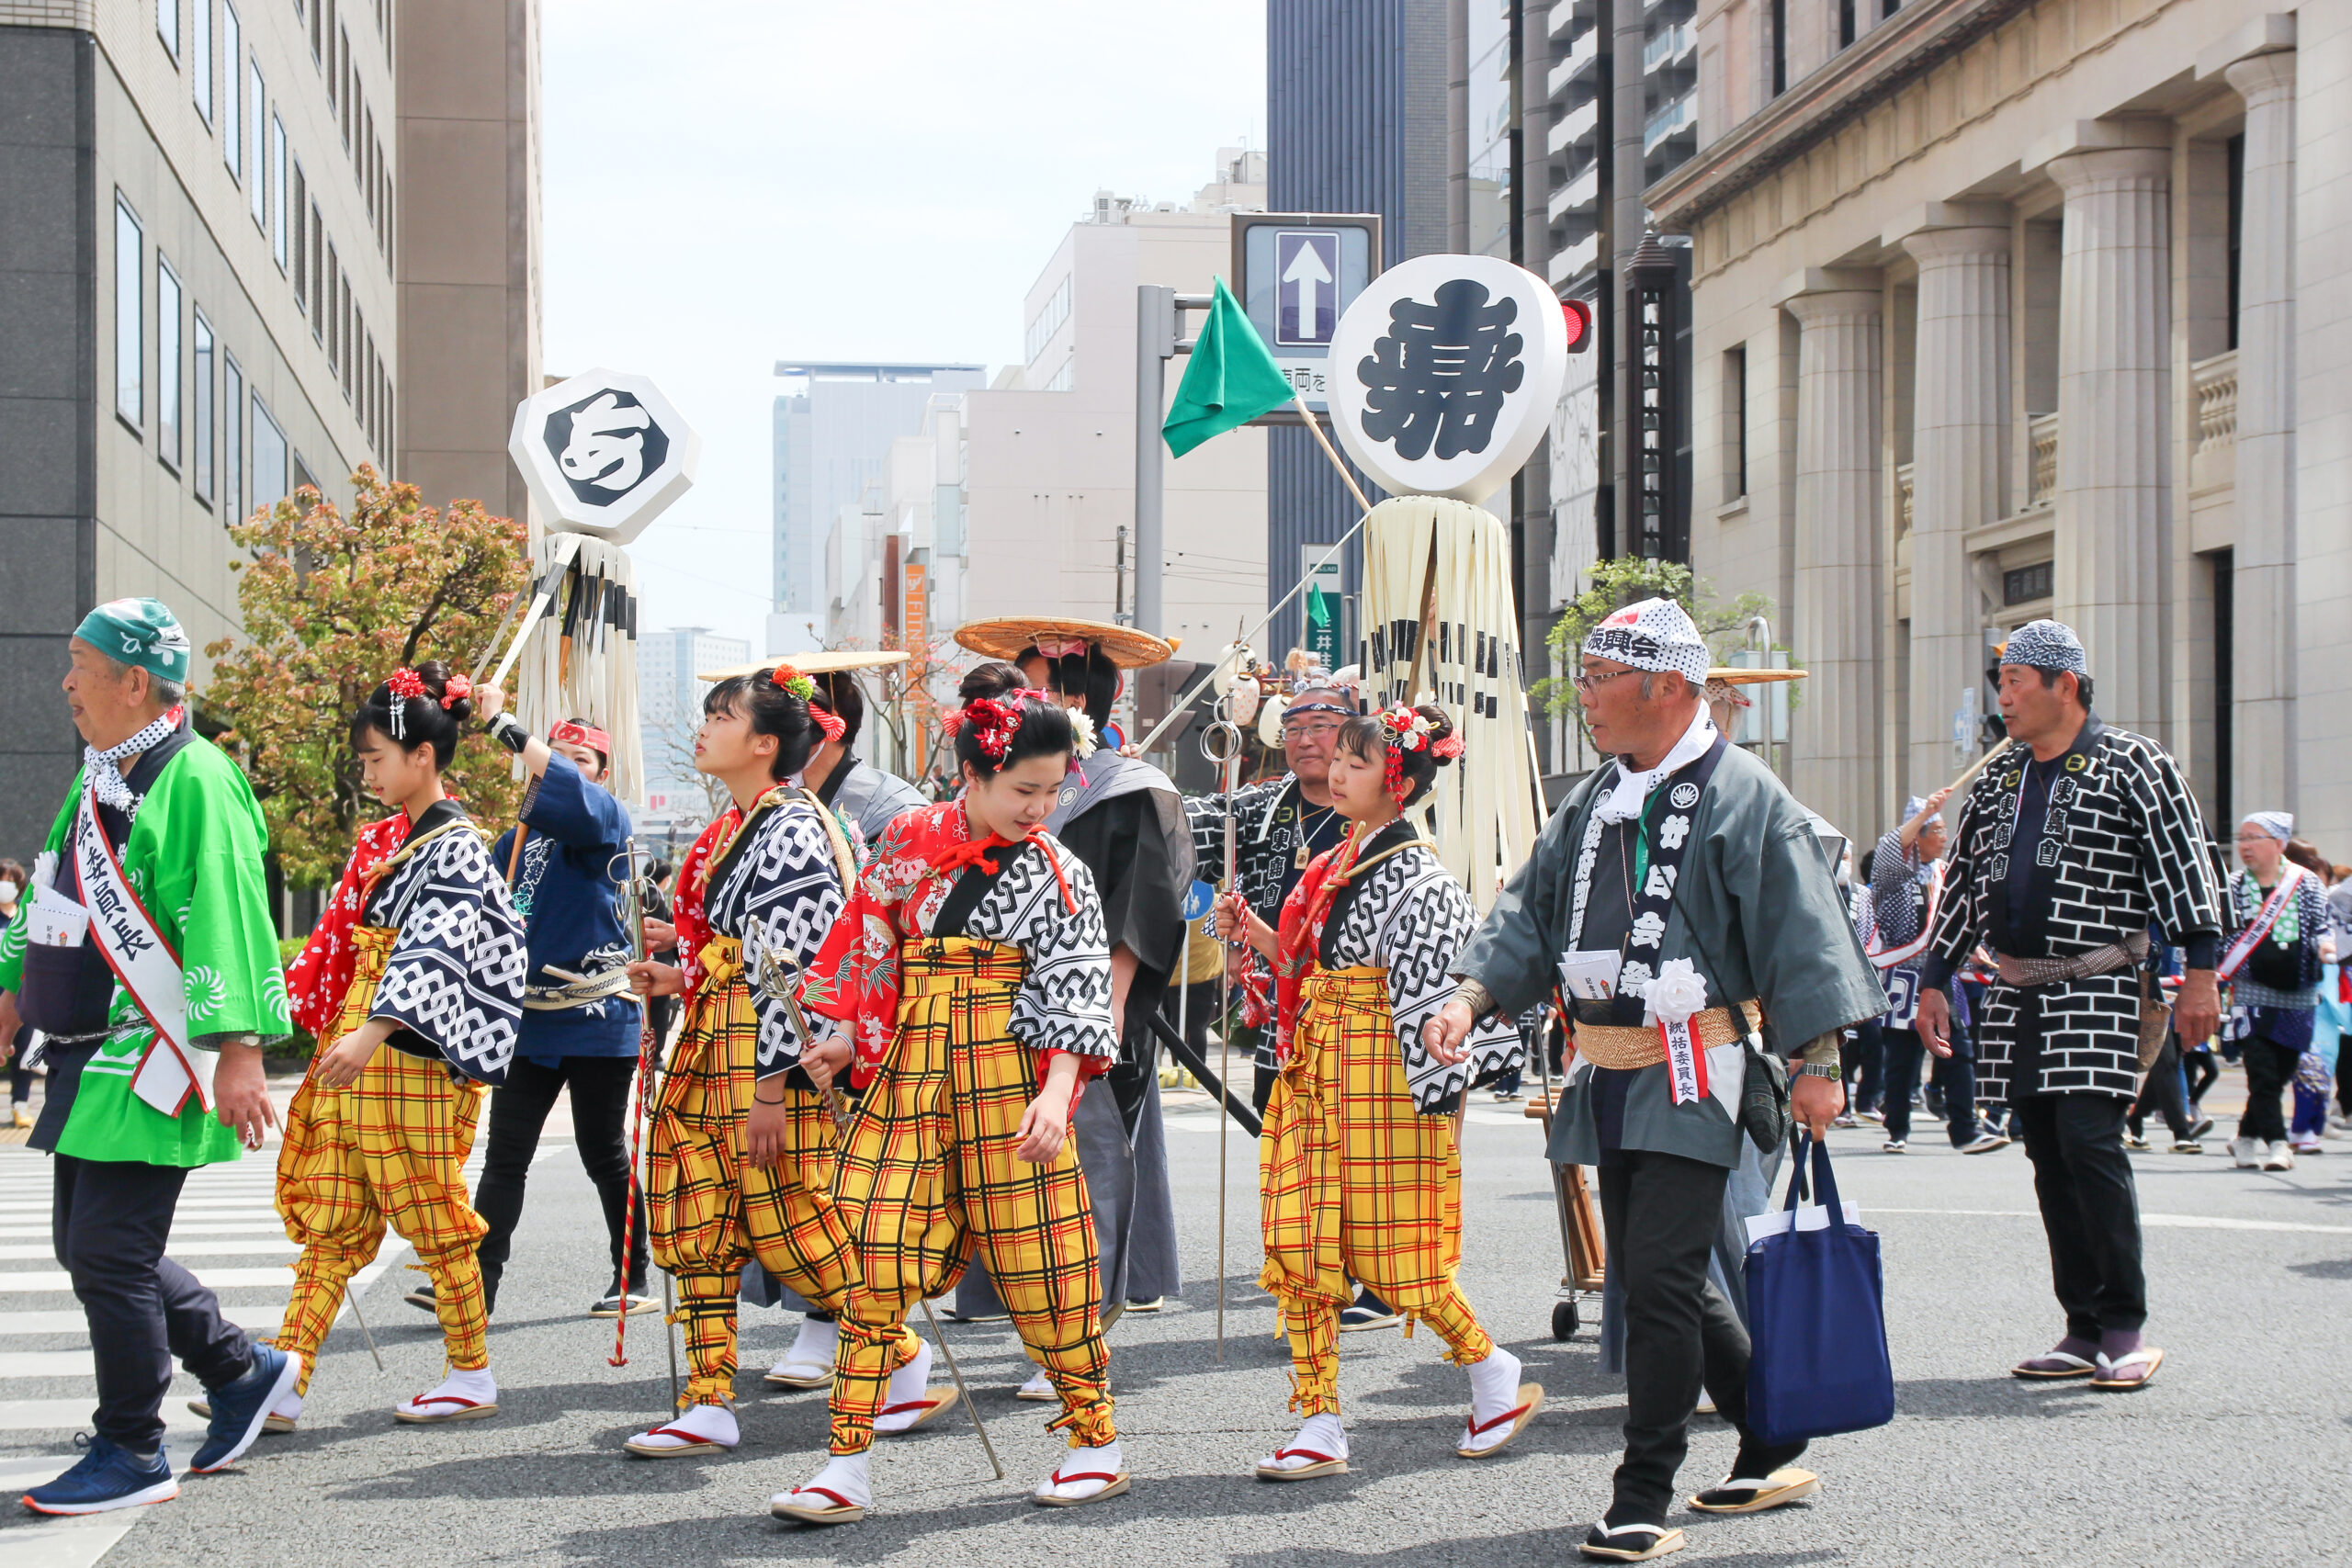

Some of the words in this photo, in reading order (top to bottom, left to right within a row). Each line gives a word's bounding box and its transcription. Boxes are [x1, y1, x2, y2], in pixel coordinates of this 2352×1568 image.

[1668, 1021, 1695, 1096] 統括委員長
